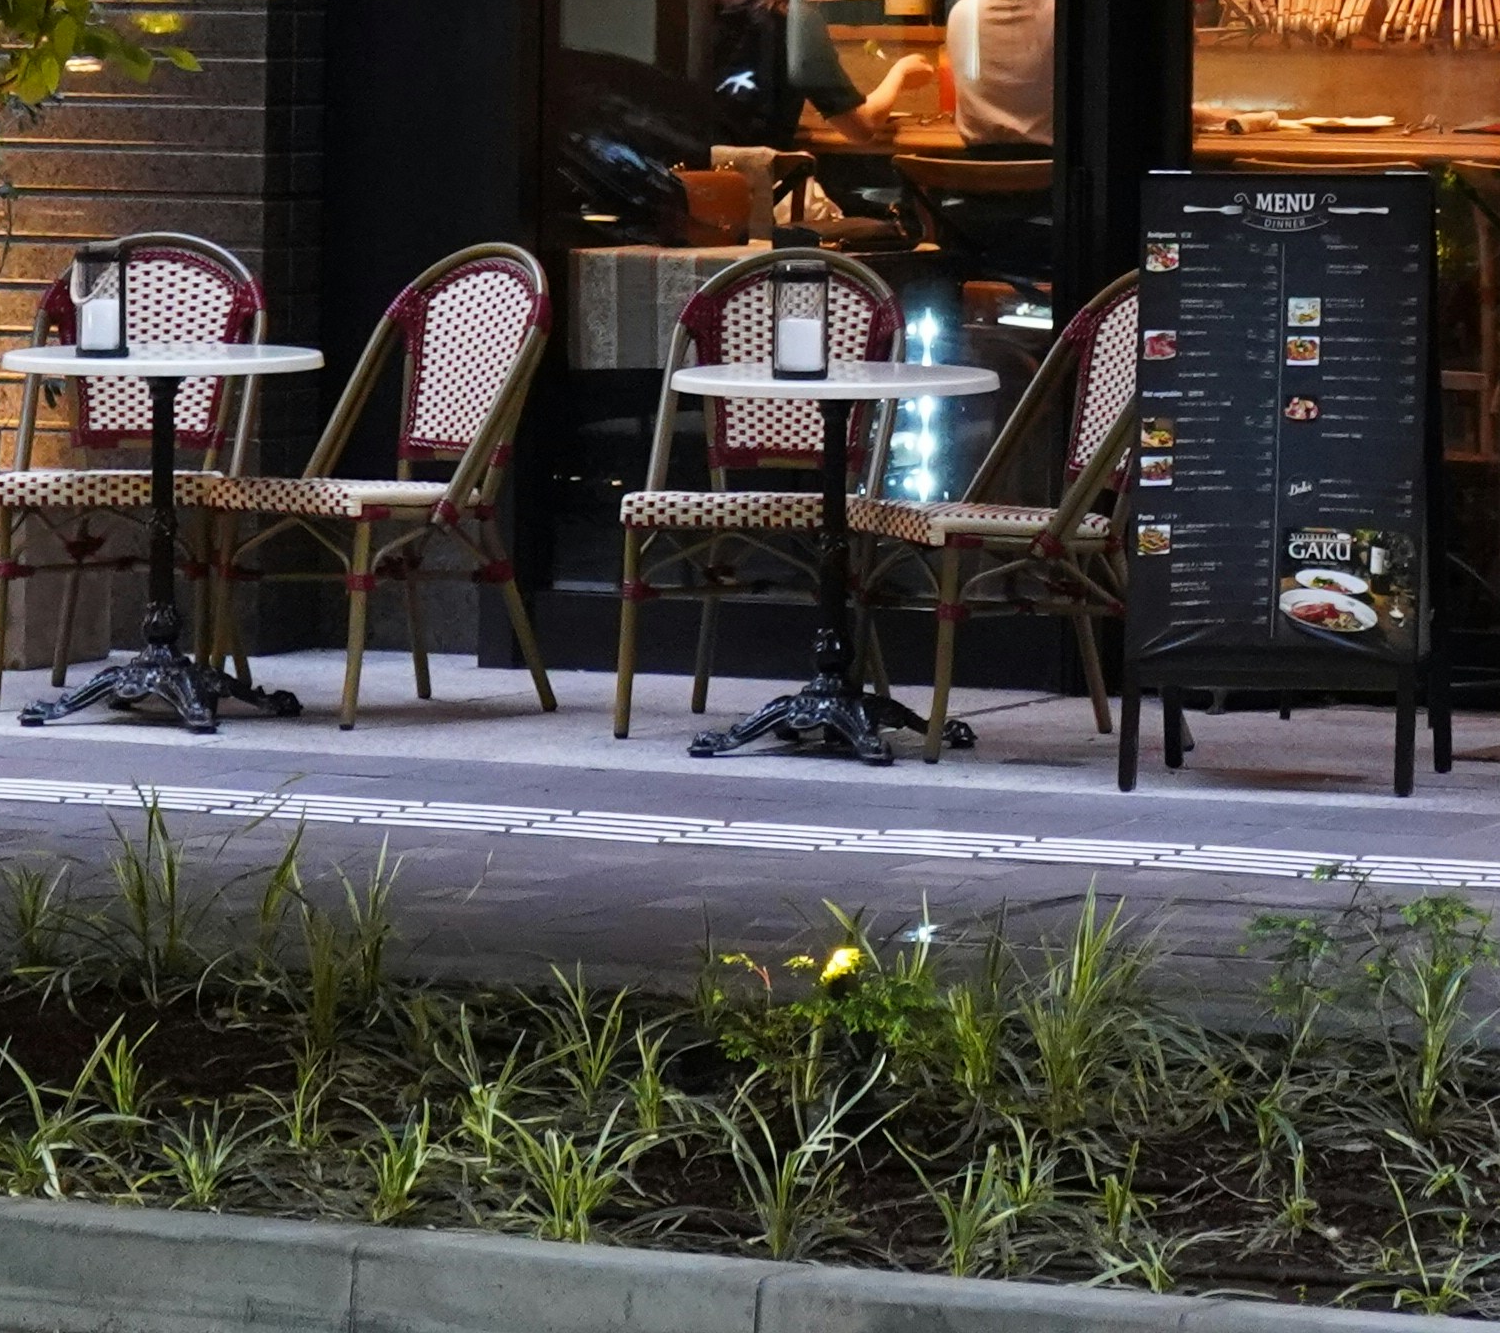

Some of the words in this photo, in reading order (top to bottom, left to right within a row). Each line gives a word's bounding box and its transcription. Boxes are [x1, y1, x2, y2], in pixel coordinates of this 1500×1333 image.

[1255, 193, 1316, 213] MENU
[1263, 217, 1306, 229] DINNER
[1288, 541, 1352, 561] GAKU
